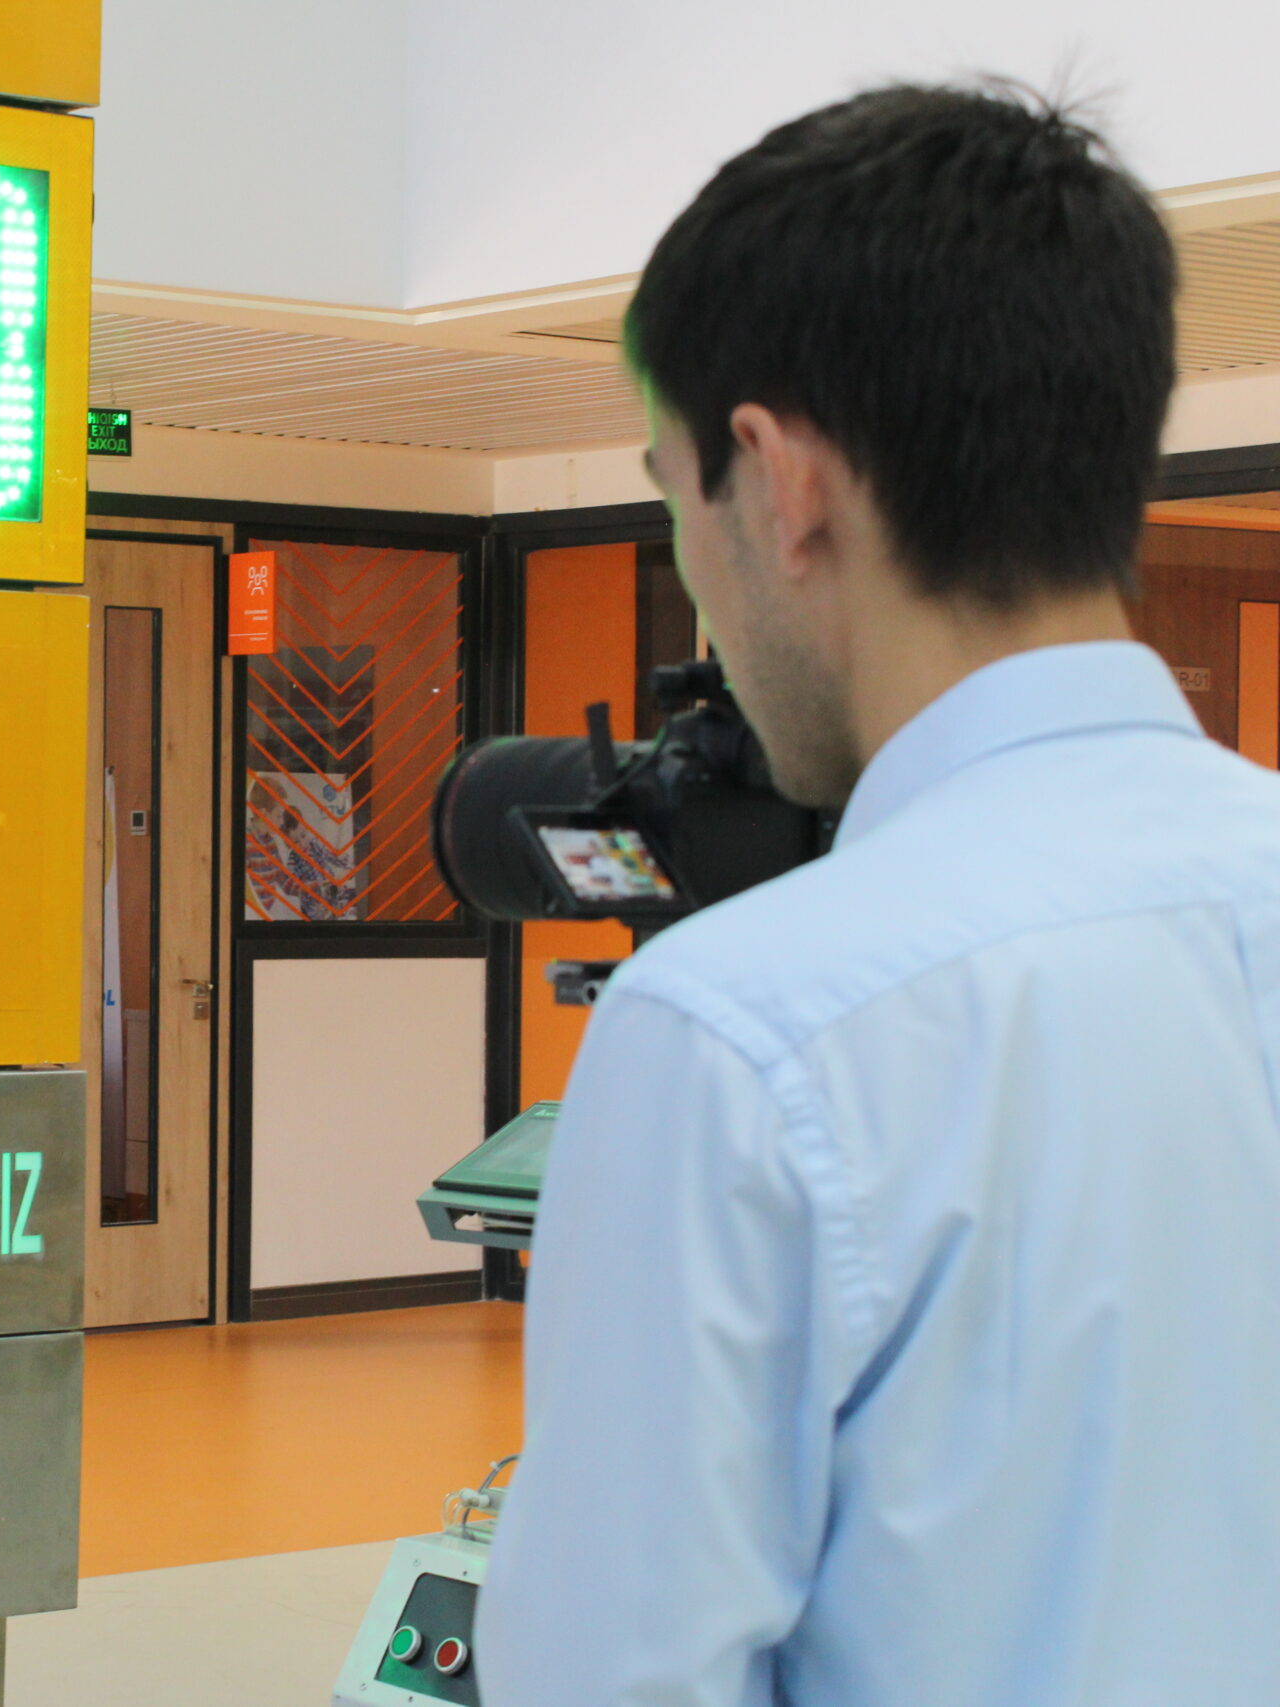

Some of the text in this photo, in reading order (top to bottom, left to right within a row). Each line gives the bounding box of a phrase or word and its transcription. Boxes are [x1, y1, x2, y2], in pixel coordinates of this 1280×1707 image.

[91, 425, 116, 437] EXIT
[87, 437, 129, 453] ЫХОД
[1178, 671, 1209, 688] R-01
